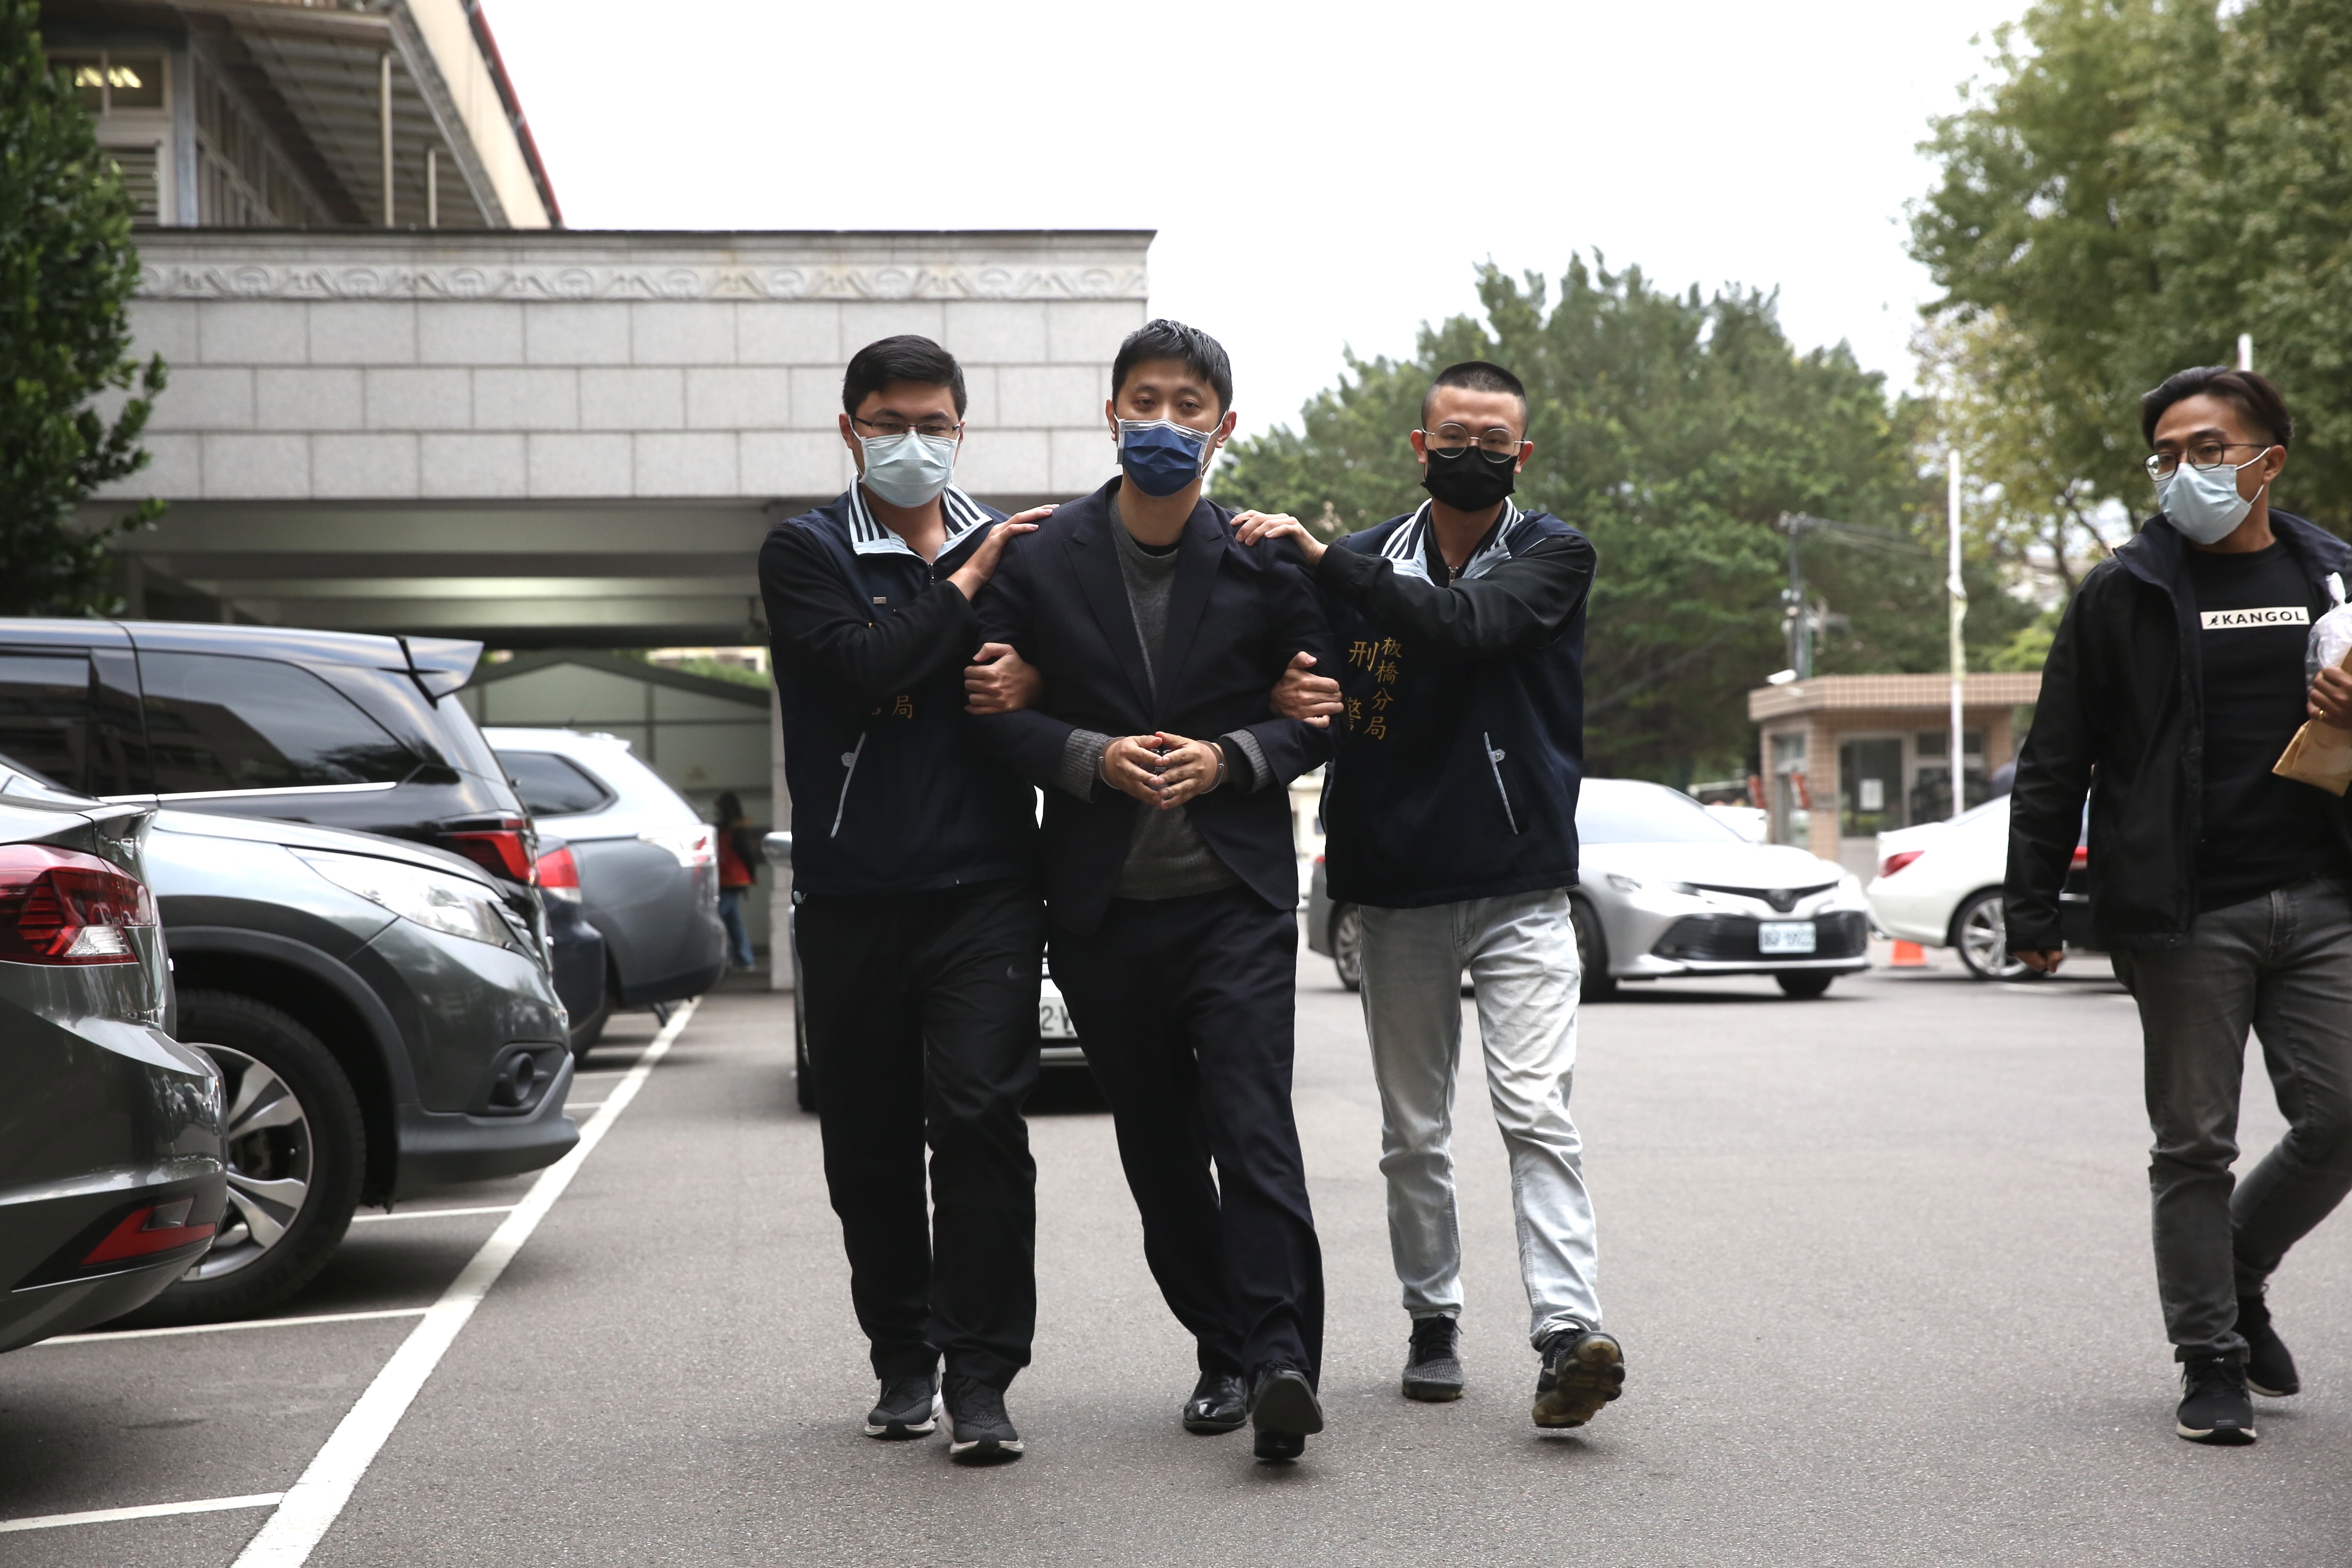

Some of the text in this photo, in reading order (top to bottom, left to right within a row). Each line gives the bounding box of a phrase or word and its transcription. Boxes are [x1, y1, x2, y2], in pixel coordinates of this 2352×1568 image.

[2223, 611, 2305, 624] KANGOL
[1363, 637, 1402, 740] 板橋分局
[892, 695, 913, 719] 局
